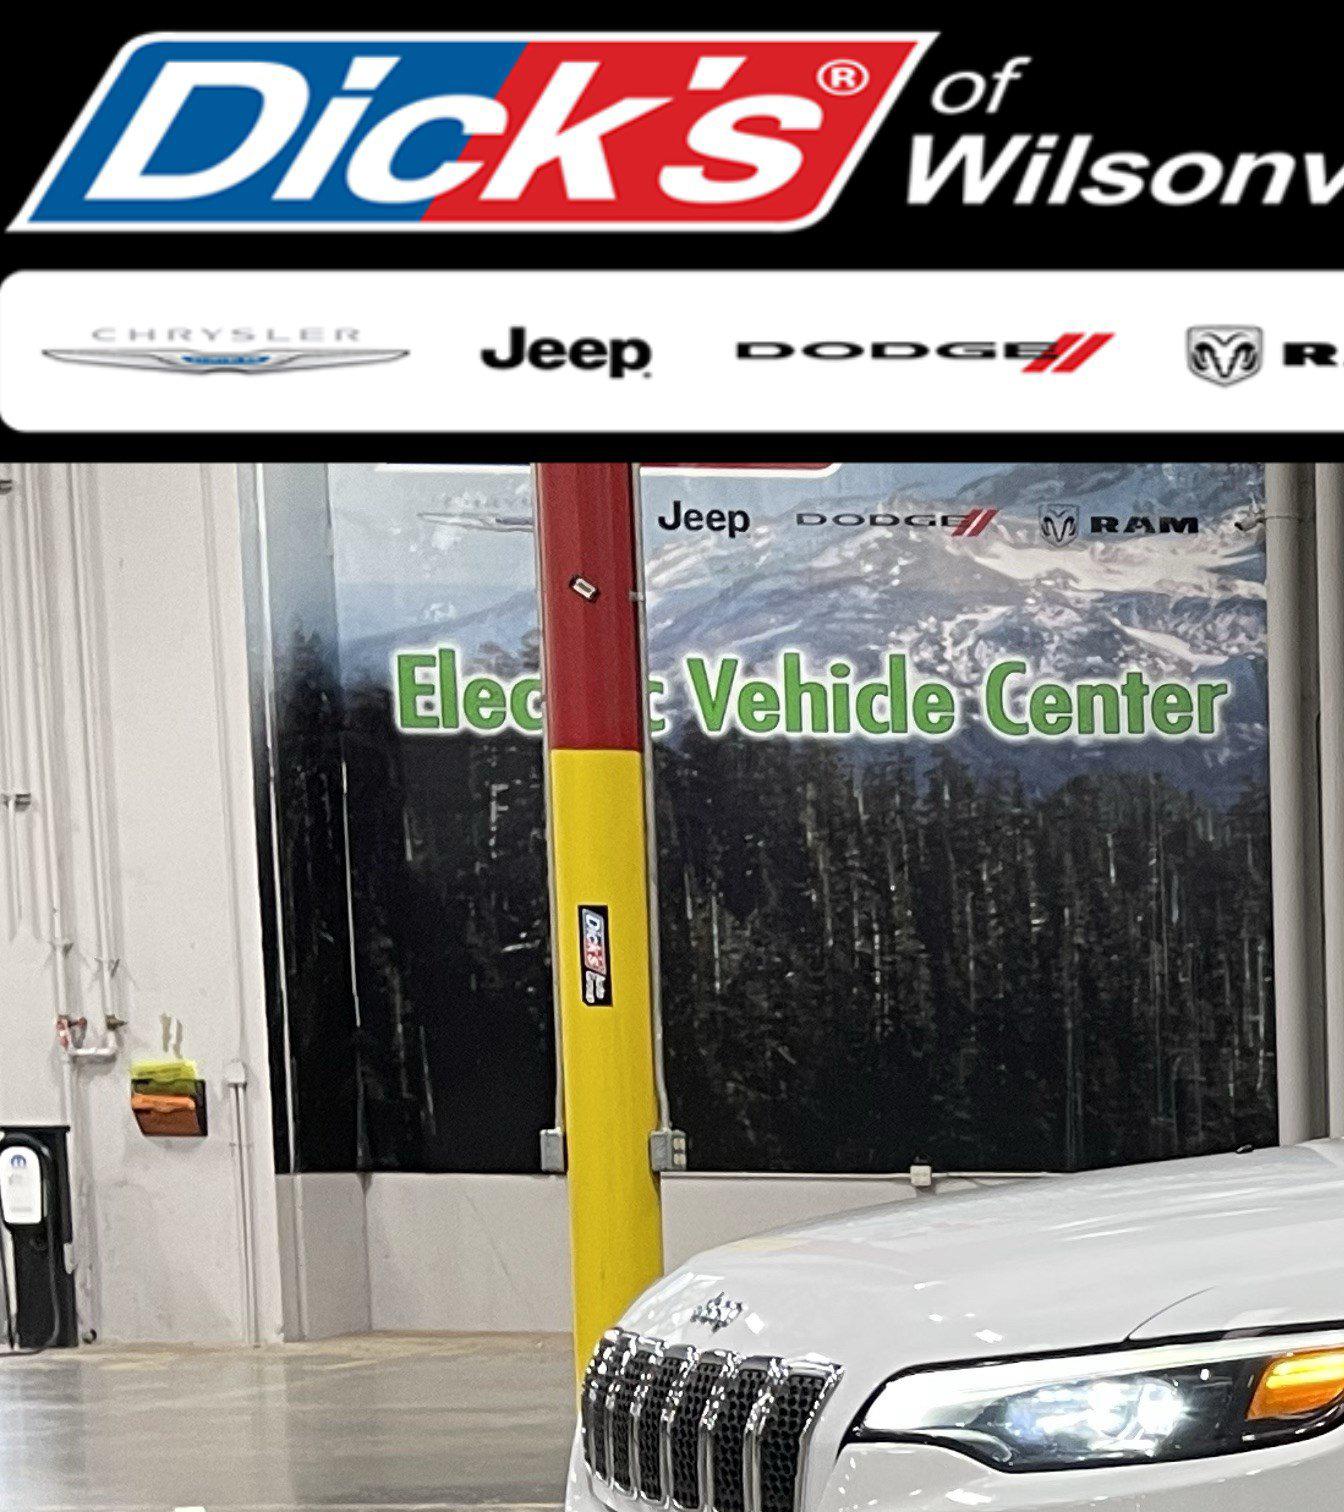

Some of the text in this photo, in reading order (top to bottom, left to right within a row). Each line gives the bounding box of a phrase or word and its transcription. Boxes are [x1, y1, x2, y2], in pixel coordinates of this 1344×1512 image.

[658, 500, 750, 539] Jeep
[796, 513, 970, 527] DODGE
[1090, 515, 1199, 534] RAM
[686, 653, 956, 735] Vehicle
[985, 660, 1229, 736] Center
